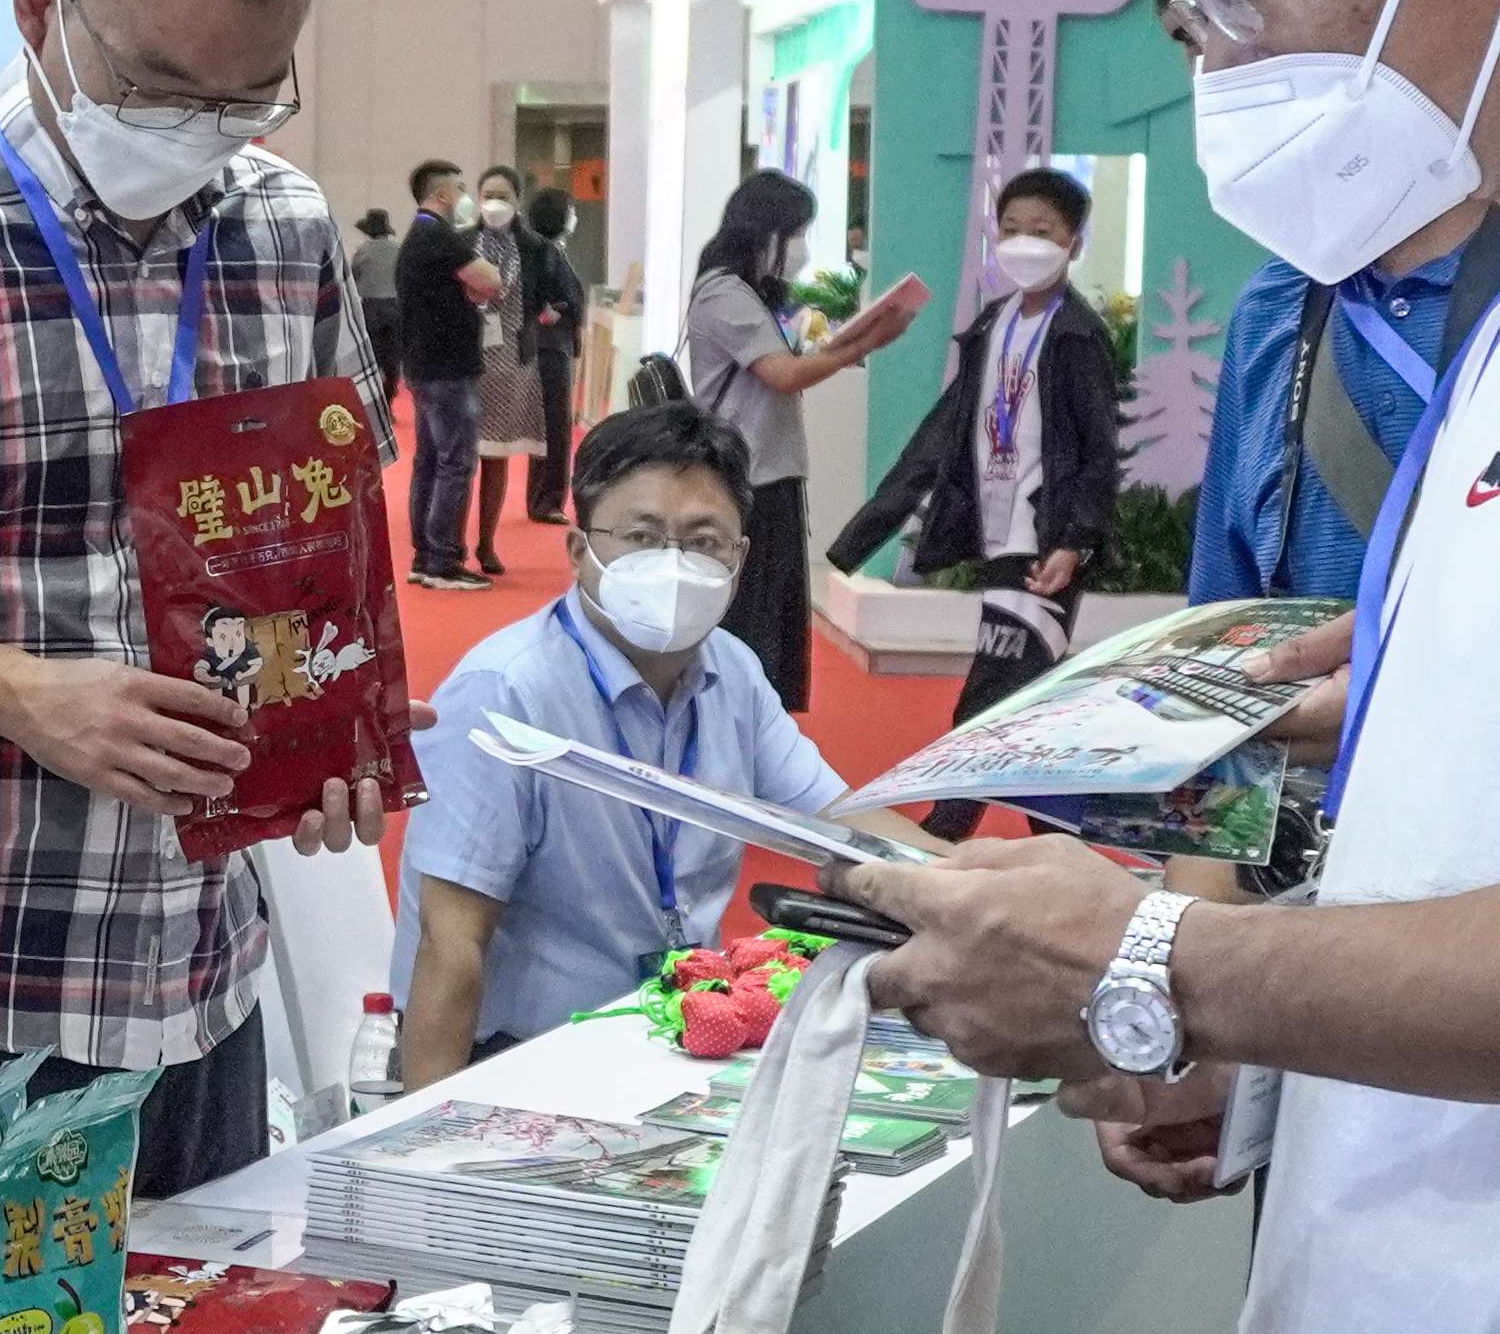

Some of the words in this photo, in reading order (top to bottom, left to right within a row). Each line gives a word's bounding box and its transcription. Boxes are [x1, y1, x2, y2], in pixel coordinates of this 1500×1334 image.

[1336, 154, 1370, 182] N95
[176, 456, 353, 547] 璧山兔
